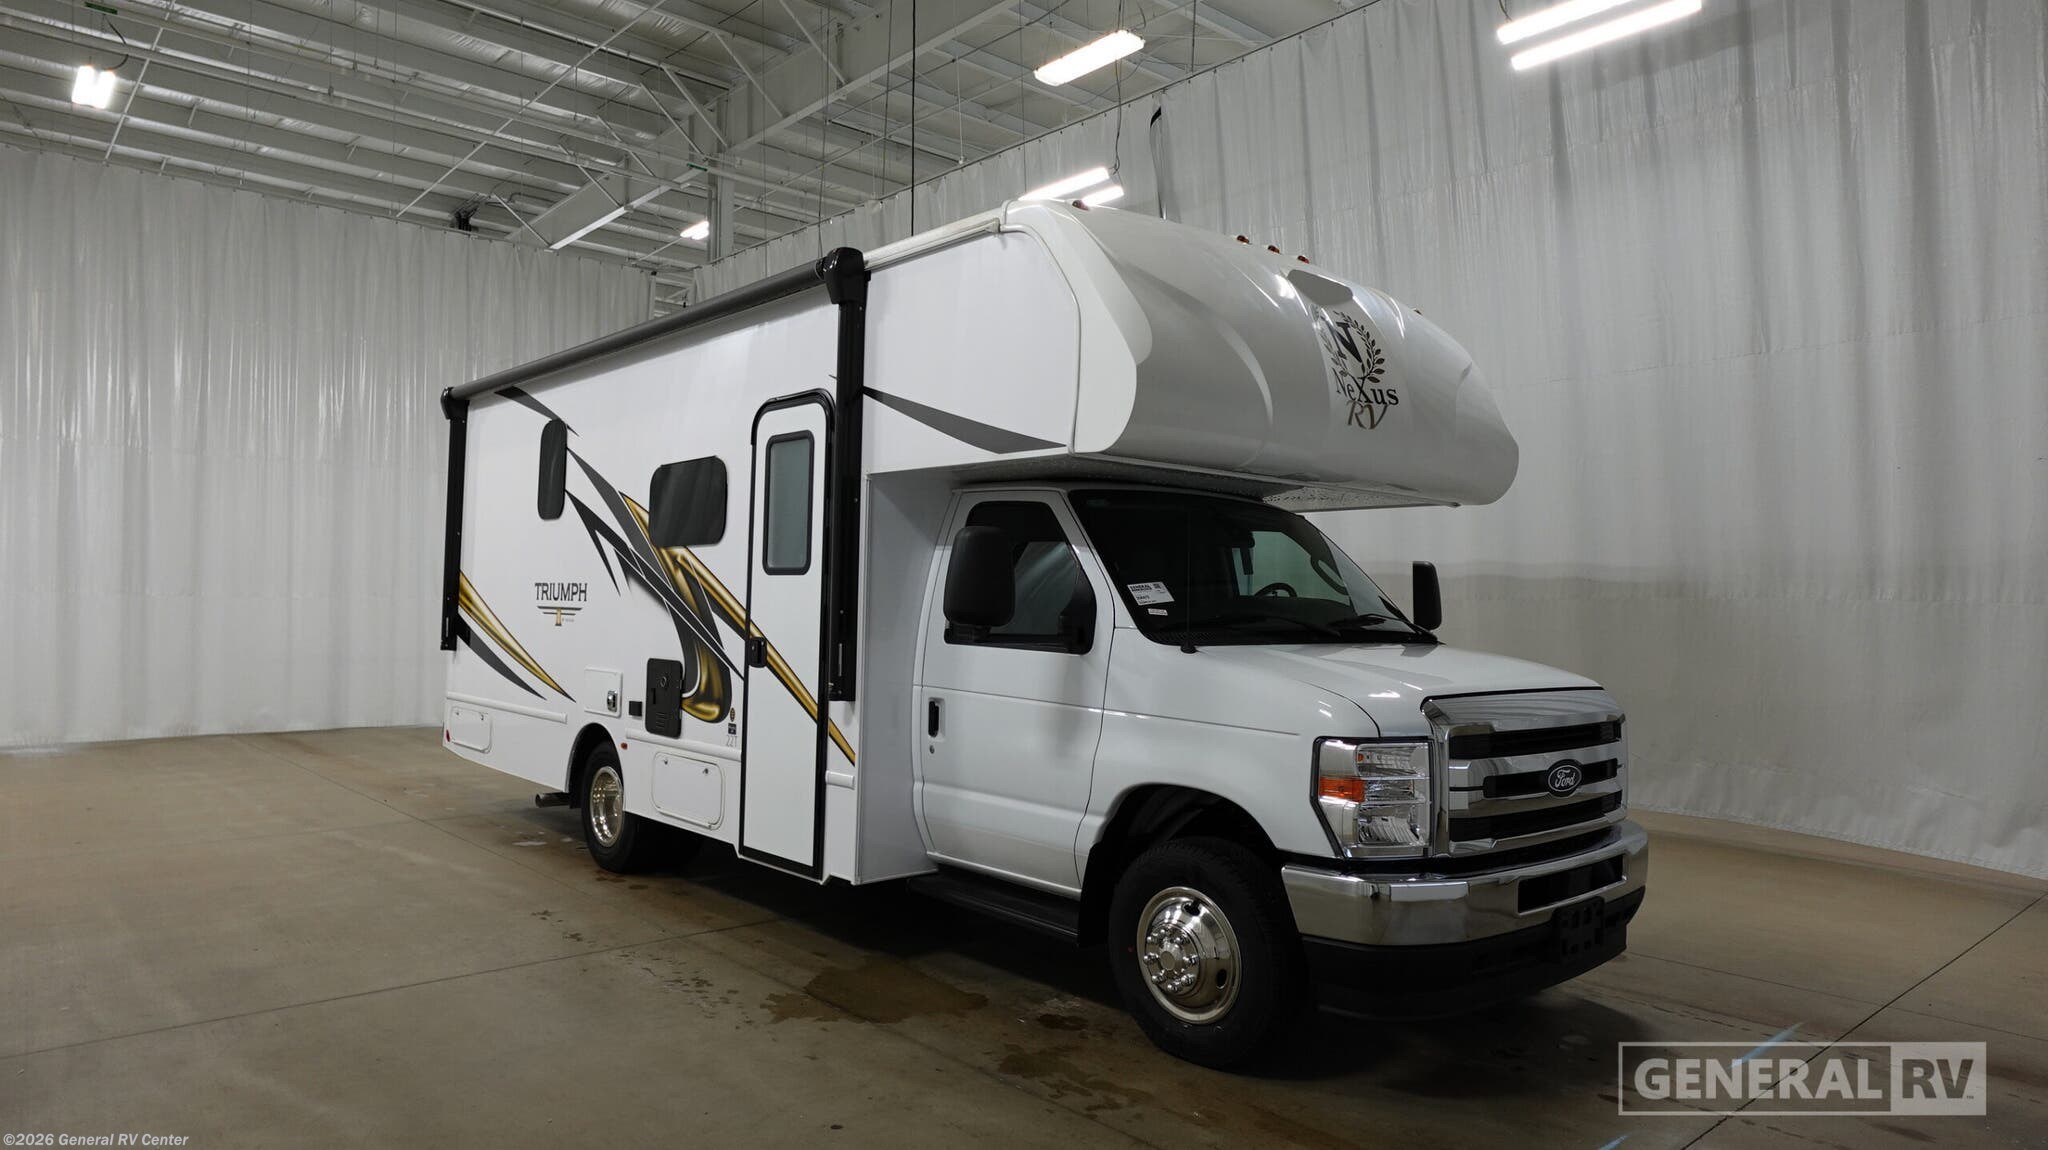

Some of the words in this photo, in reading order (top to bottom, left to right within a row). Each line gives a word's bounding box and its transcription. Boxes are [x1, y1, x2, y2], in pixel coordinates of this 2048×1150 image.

[1346, 400, 1388, 430] RV
[534, 582, 588, 602] TRIUMPH
[1554, 769, 1576, 788] Ford
